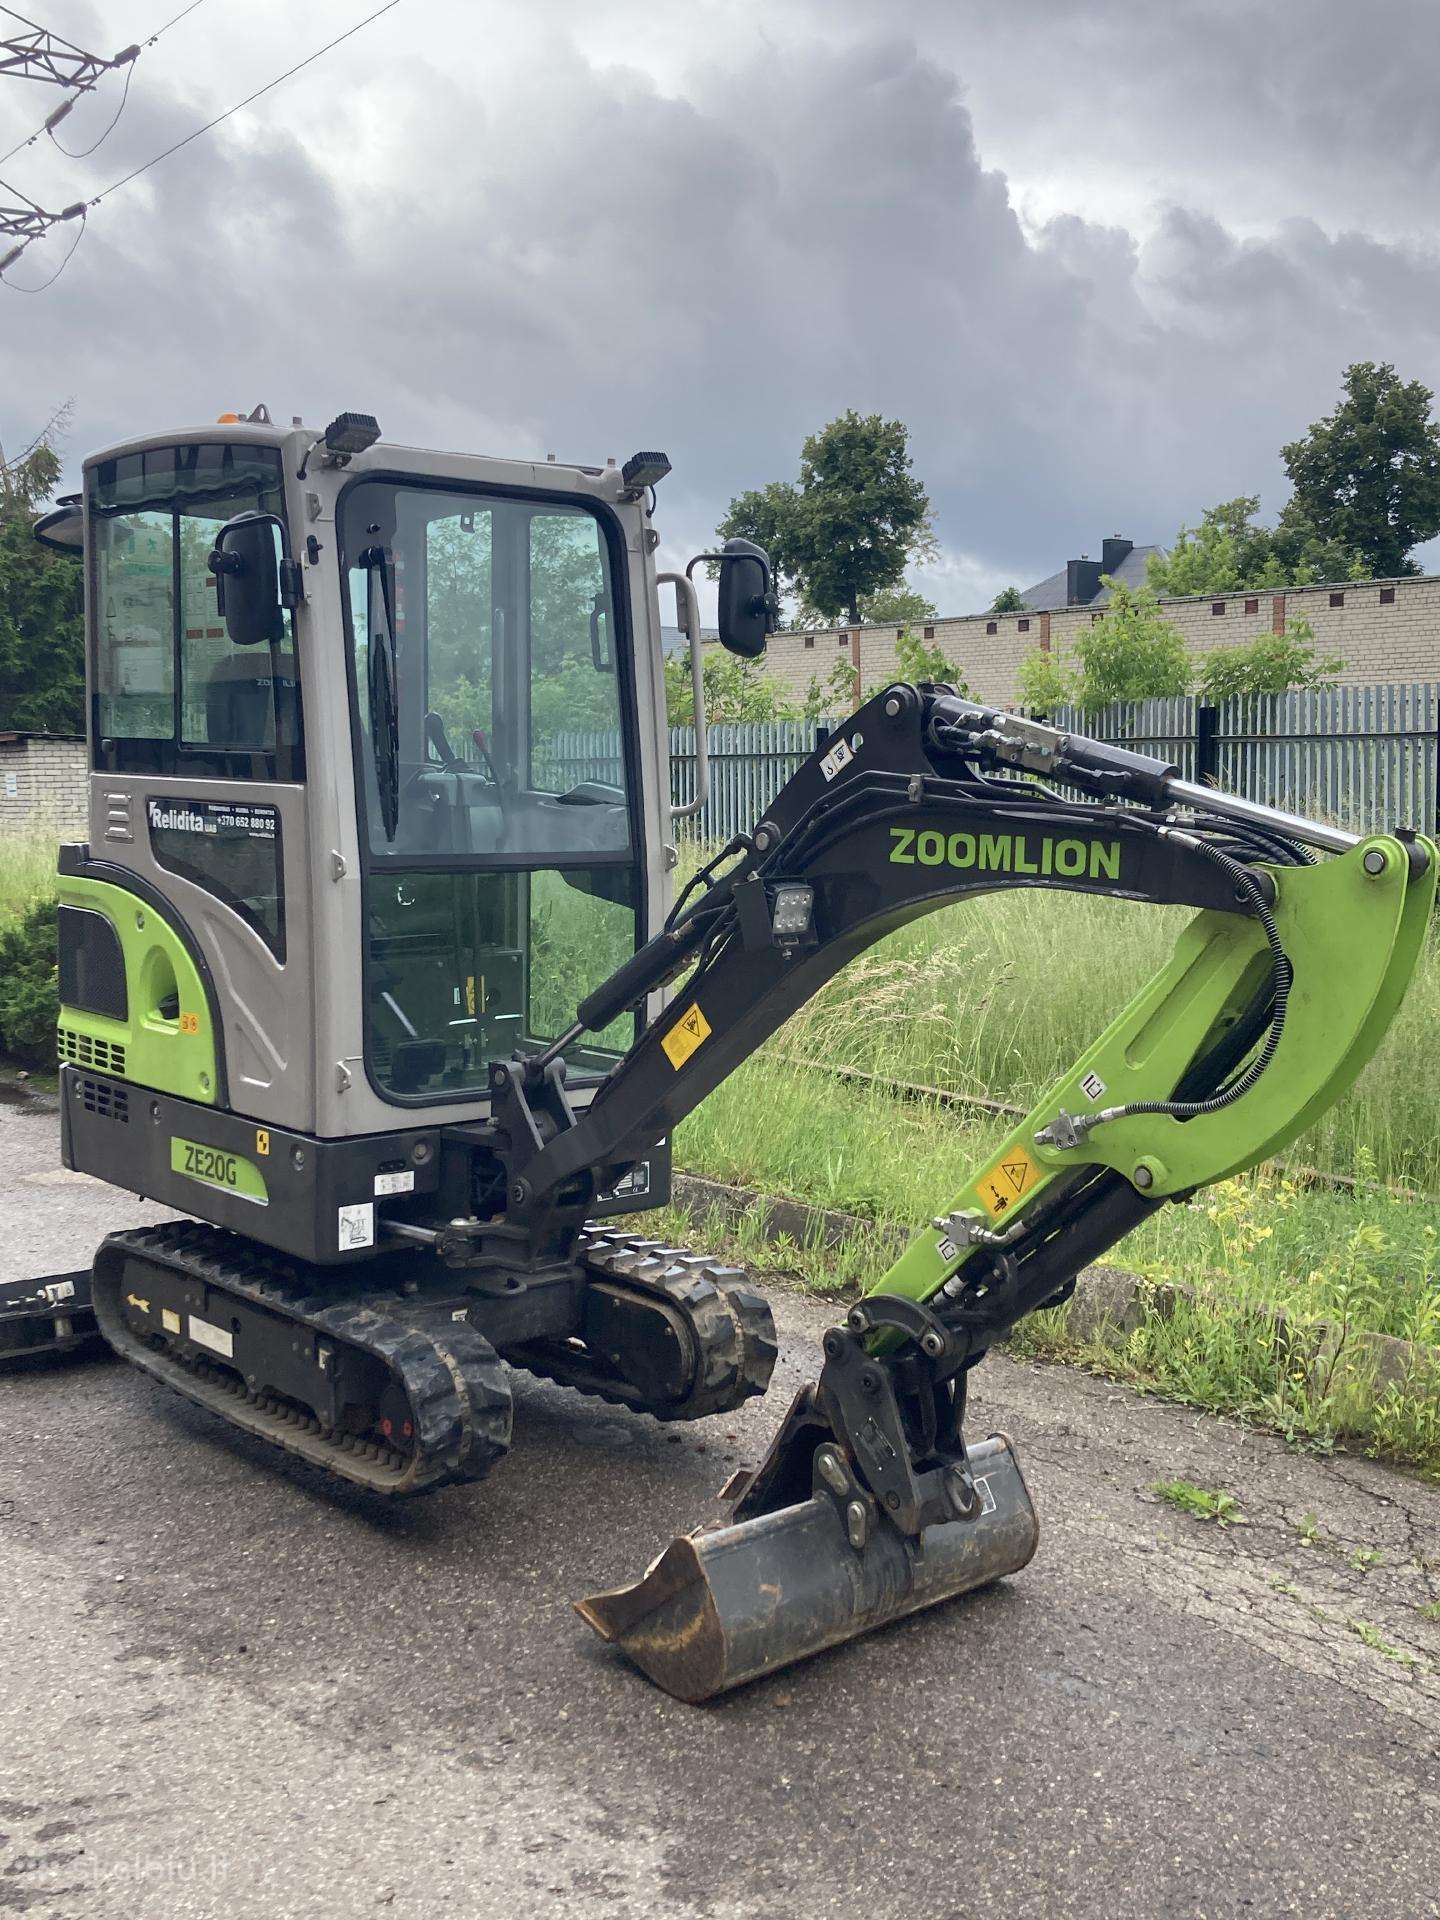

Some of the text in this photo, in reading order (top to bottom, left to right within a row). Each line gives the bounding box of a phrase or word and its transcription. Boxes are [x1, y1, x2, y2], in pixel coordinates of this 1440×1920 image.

[152, 808, 204, 833] Relidita
[216, 815, 234, 826] +370
[235, 816, 249, 828] 652
[265, 819, 275, 830] 92
[889, 828, 1121, 880] ZOOMLION
[184, 1146, 237, 1186] ZE20G
